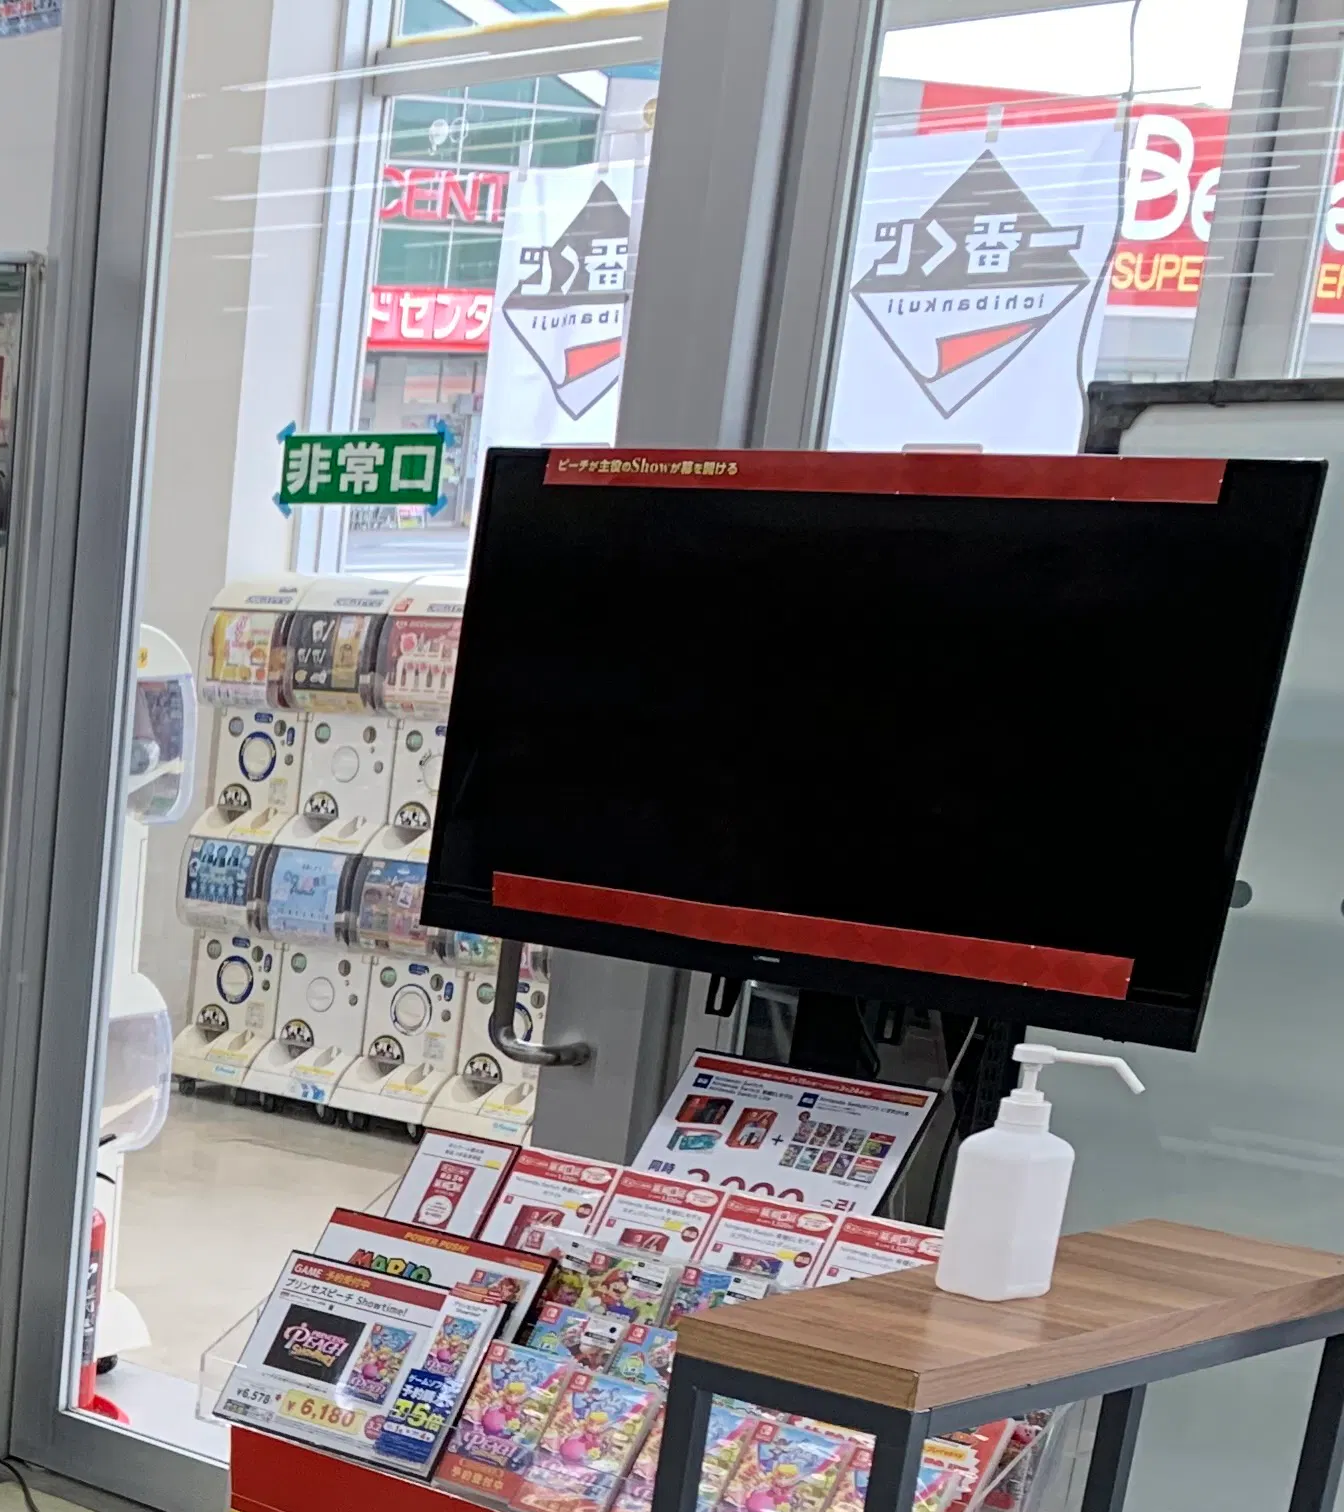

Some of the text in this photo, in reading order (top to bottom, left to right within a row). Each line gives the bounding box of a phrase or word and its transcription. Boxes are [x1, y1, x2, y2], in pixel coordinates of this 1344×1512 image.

[286, 441, 438, 496] 非常口
[294, 1263, 324, 1278] GAME
[285, 1277, 409, 1318] プリンセスピーチ Showtime!
[283, 1322, 350, 1357] PEACH
[300, 1398, 356, 1427] 6,180
